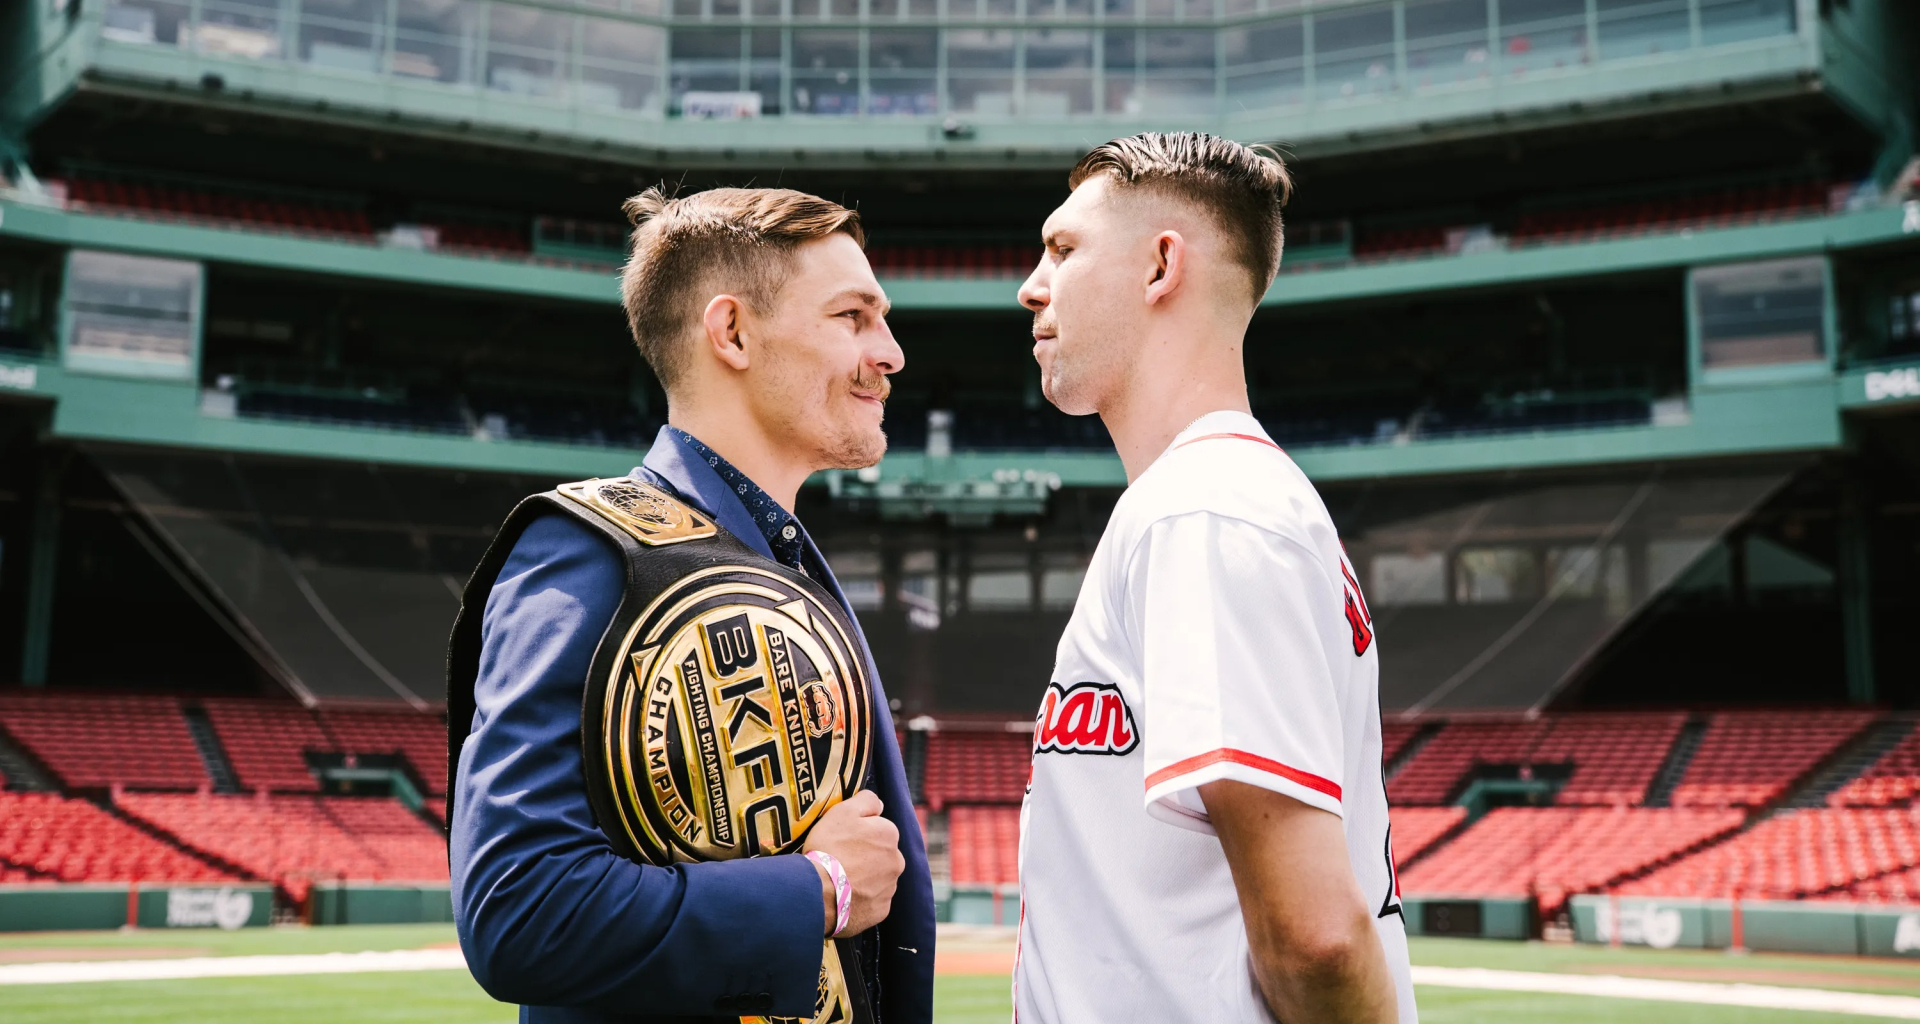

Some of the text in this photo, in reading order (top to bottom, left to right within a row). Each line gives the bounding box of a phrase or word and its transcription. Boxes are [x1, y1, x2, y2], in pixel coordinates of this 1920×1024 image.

[647, 675, 704, 845] CHAMPION
[684, 659, 731, 841] FIGHTING CHAMPIONSHIP
[704, 612, 793, 858] BKFC
[768, 632, 814, 806] BARE KNUCKLE
